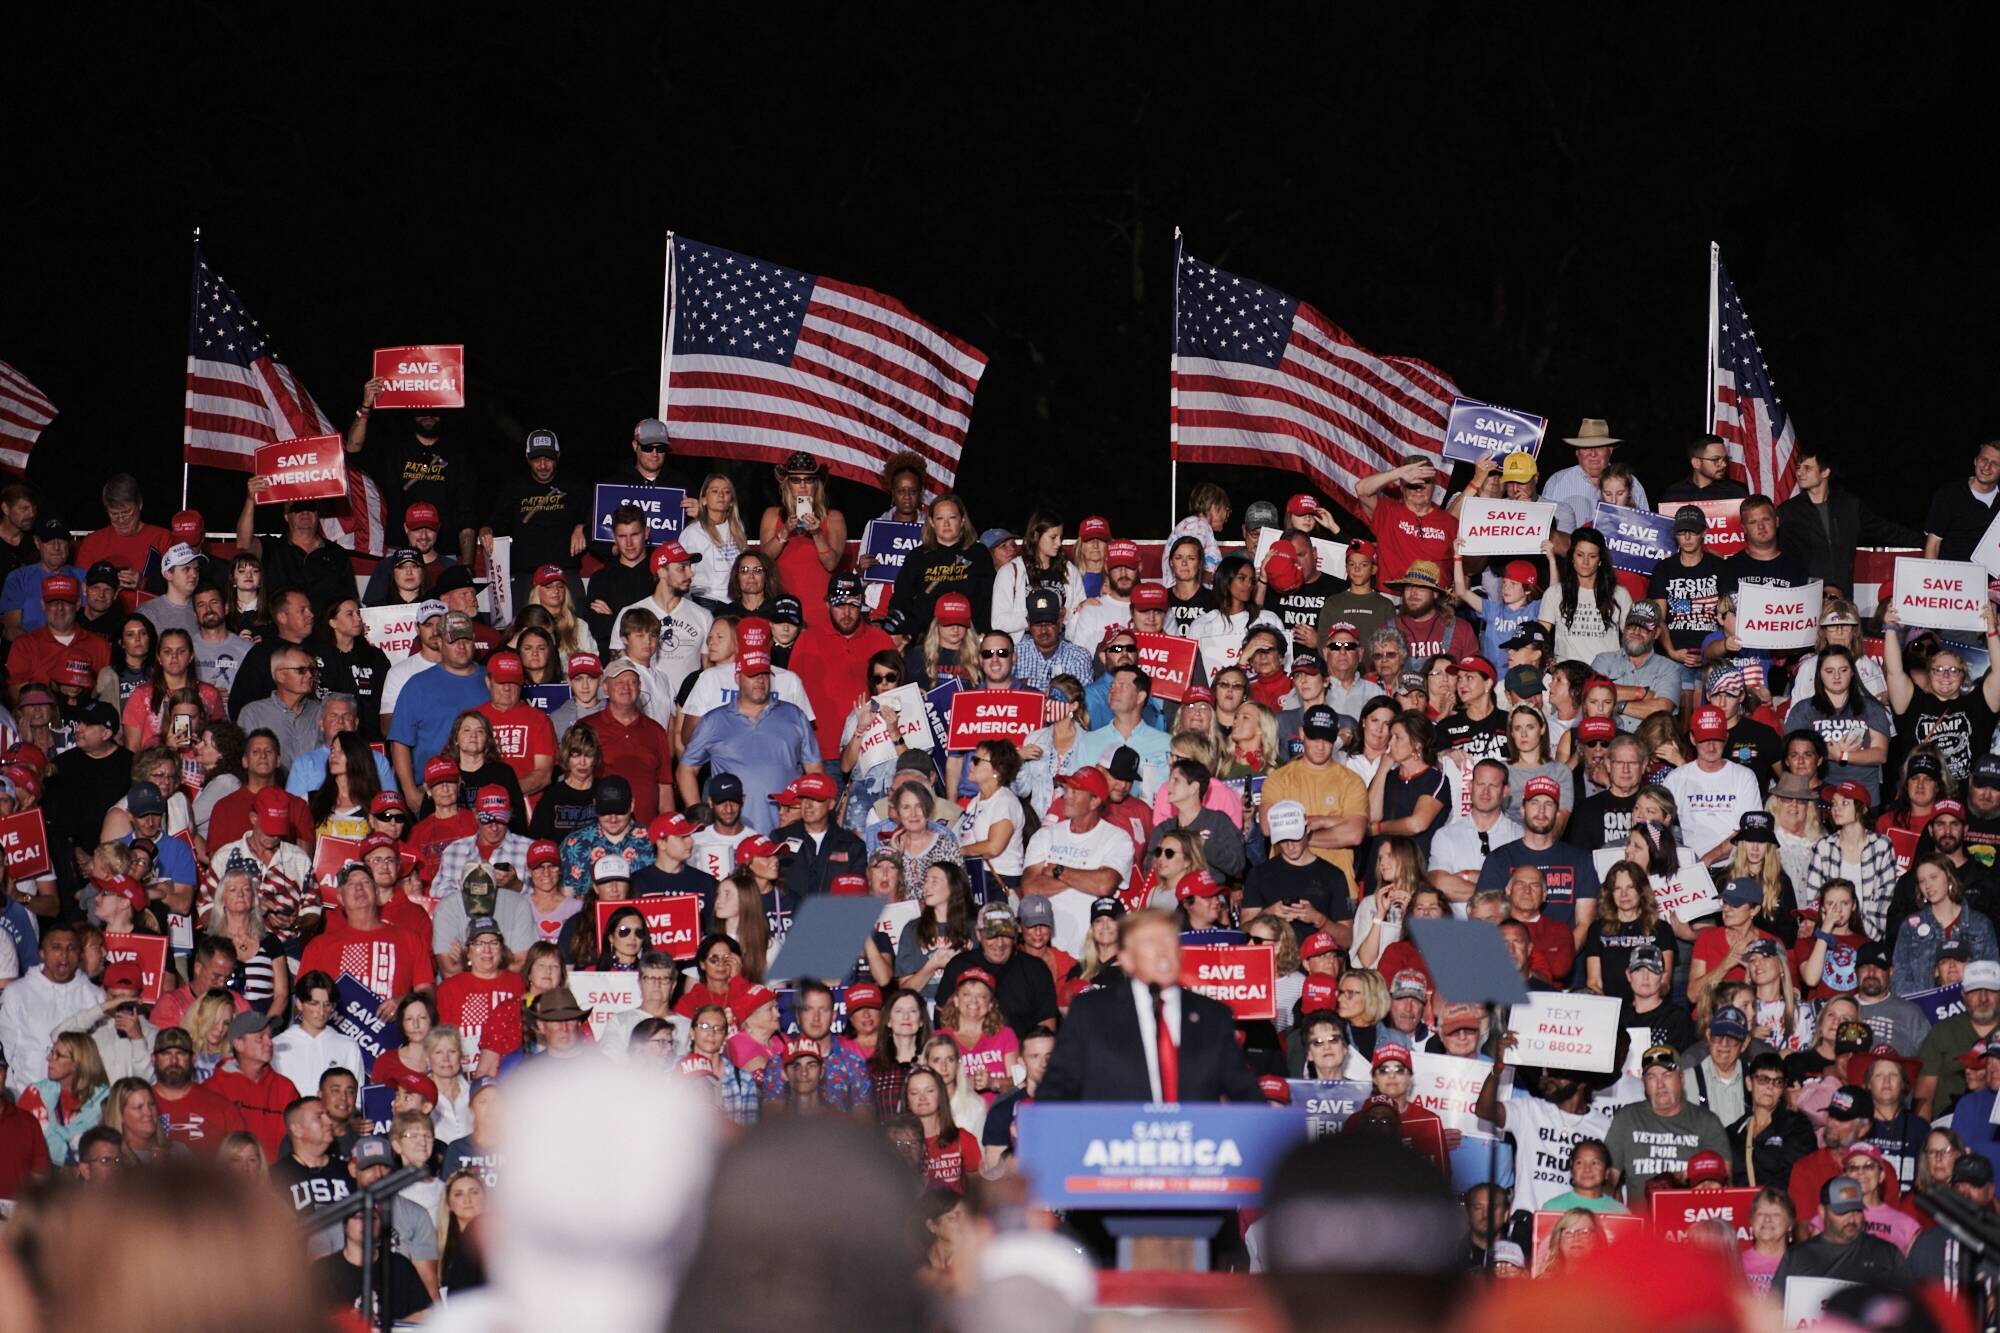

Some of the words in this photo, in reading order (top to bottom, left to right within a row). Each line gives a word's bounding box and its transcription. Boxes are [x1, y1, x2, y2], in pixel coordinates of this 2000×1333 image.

[398, 362, 438, 374] SAVE
[1475, 417, 1516, 437] SAVE
[1454, 432, 1529, 454] AMERICA!
[277, 453, 318, 468] SAVE
[405, 461, 443, 474] PATRIOT
[521, 495, 561, 506] PATRIOT
[602, 513, 677, 531] AICA!
[1487, 511, 1527, 521] SAVE
[1706, 517, 1727, 528] VE
[1468, 526, 1541, 537] AMERICA!
[1618, 523, 1659, 542] SAVE
[1704, 532, 1745, 544] RICA!
[893, 538, 923, 550] SAV
[925, 564, 966, 577] PATRIOT
[495, 564, 505, 604] SAVE
[1666, 574, 1718, 592] JESUS
[1923, 578, 1963, 592] SAVE
[420, 605, 446, 614] TRUMP
[1764, 603, 1804, 615] SAVE
[1903, 595, 1979, 612] AMERICA!
[1284, 611, 1317, 625] NOT
[1745, 616, 1818, 632] AMERICA!
[384, 621, 414, 634] SAV
[1139, 649, 1169, 663] AVE
[1141, 665, 1183, 684] RICA!
[526, 698, 548, 708] VE
[976, 706, 1018, 718] SAVE
[957, 721, 1035, 735] AMERICA!
[1922, 718, 1962, 736] TRUMP
[1687, 794, 1736, 803] TRUMP
[1603, 812, 1632, 829] ON
[1652, 882, 1684, 897] AVE
[1657, 890, 1708, 913] ERICA!
[647, 913, 671, 927] VE
[1600, 935, 1656, 948] TRUMP
[1199, 965, 1246, 980] SAVE
[1308, 984, 1331, 995] Trump
[588, 992, 632, 1004] SAVE
[346, 1001, 385, 1034] SAVE
[1547, 1007, 1581, 1020] TEXT
[331, 1010, 386, 1058] MERICA!
[1538, 1023, 1584, 1037] RALLY
[787, 1040, 819, 1056] MAGA
[1526, 1037, 1545, 1049] TO
[1548, 1041, 1593, 1055] 88022
[681, 1055, 712, 1073] MAGA
[1435, 1077, 1482, 1093] SAVE
[1306, 1099, 1354, 1114] SAVE
[1371, 1095, 1393, 1106] USA
[1132, 1120, 1193, 1141] SAVE
[1632, 1131, 1699, 1147] VETERANS
[1083, 1138, 1243, 1167] AMERICA
[1559, 1146, 1573, 1156] FO
[1649, 1145, 1677, 1158] FOR
[1535, 1151, 1571, 1172] TRU
[290, 1178, 350, 1211] USA
[1684, 1206, 1733, 1222] SAVE
